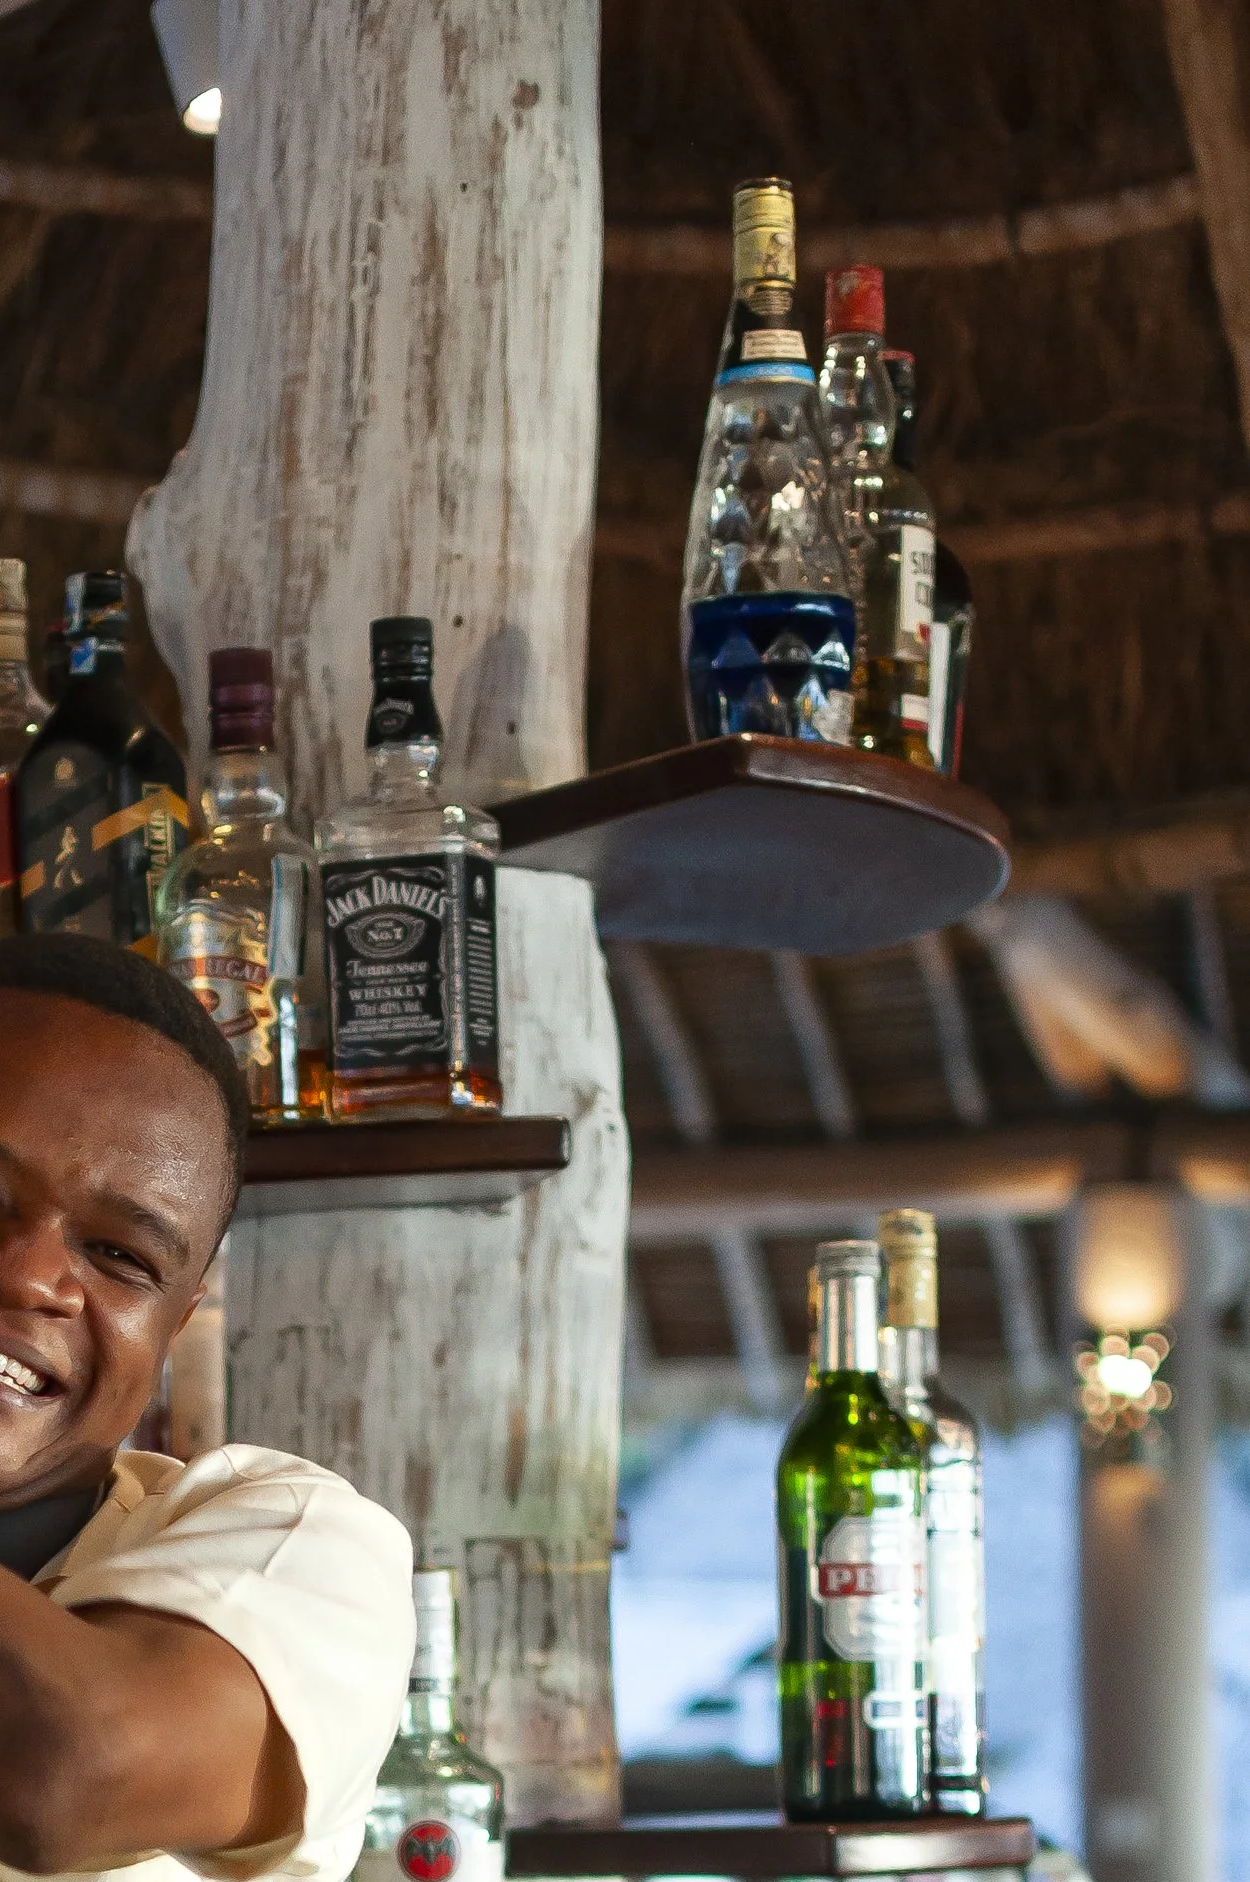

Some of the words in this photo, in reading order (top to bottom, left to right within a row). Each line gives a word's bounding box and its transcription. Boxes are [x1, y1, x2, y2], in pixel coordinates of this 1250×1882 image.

[326, 886, 372, 928] JACK
[346, 960, 429, 978] Tennessee
[349, 984, 429, 1001] WHISKEY
